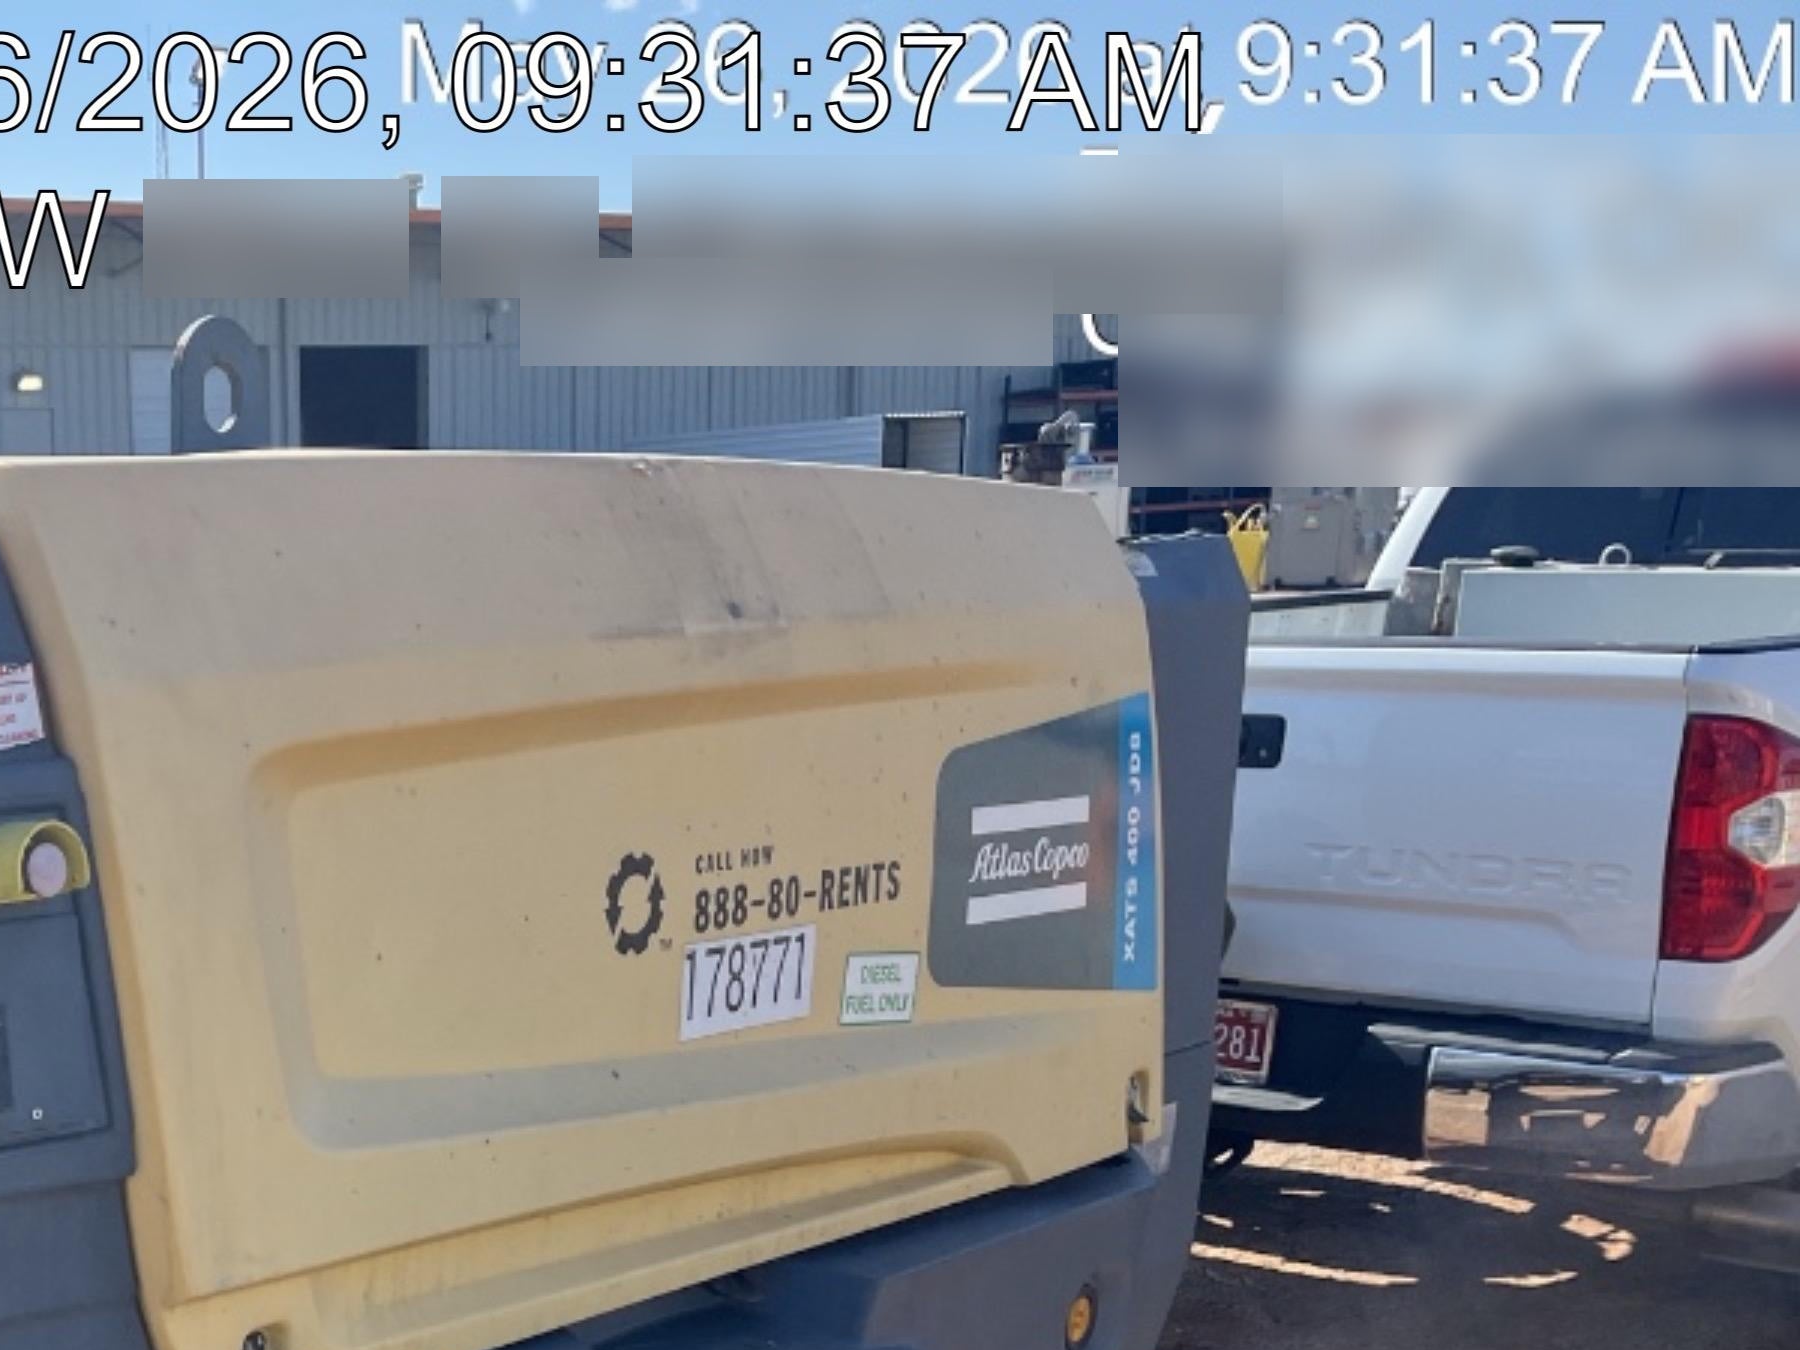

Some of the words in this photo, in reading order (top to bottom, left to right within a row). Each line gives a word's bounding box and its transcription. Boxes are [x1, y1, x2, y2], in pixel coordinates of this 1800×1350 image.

[968, 842, 1033, 882] Atlas
[1034, 836, 1090, 881] Copco
[1126, 805, 1141, 866] 400
[695, 851, 732, 874] CALL
[695, 860, 901, 934] 888-80-RENTS
[1123, 876, 1138, 963] XATS
[686, 932, 806, 1022] 178771
[860, 962, 902, 985] DIESEL
[846, 993, 874, 1015] FUEL
[879, 991, 910, 1012] ONLY
